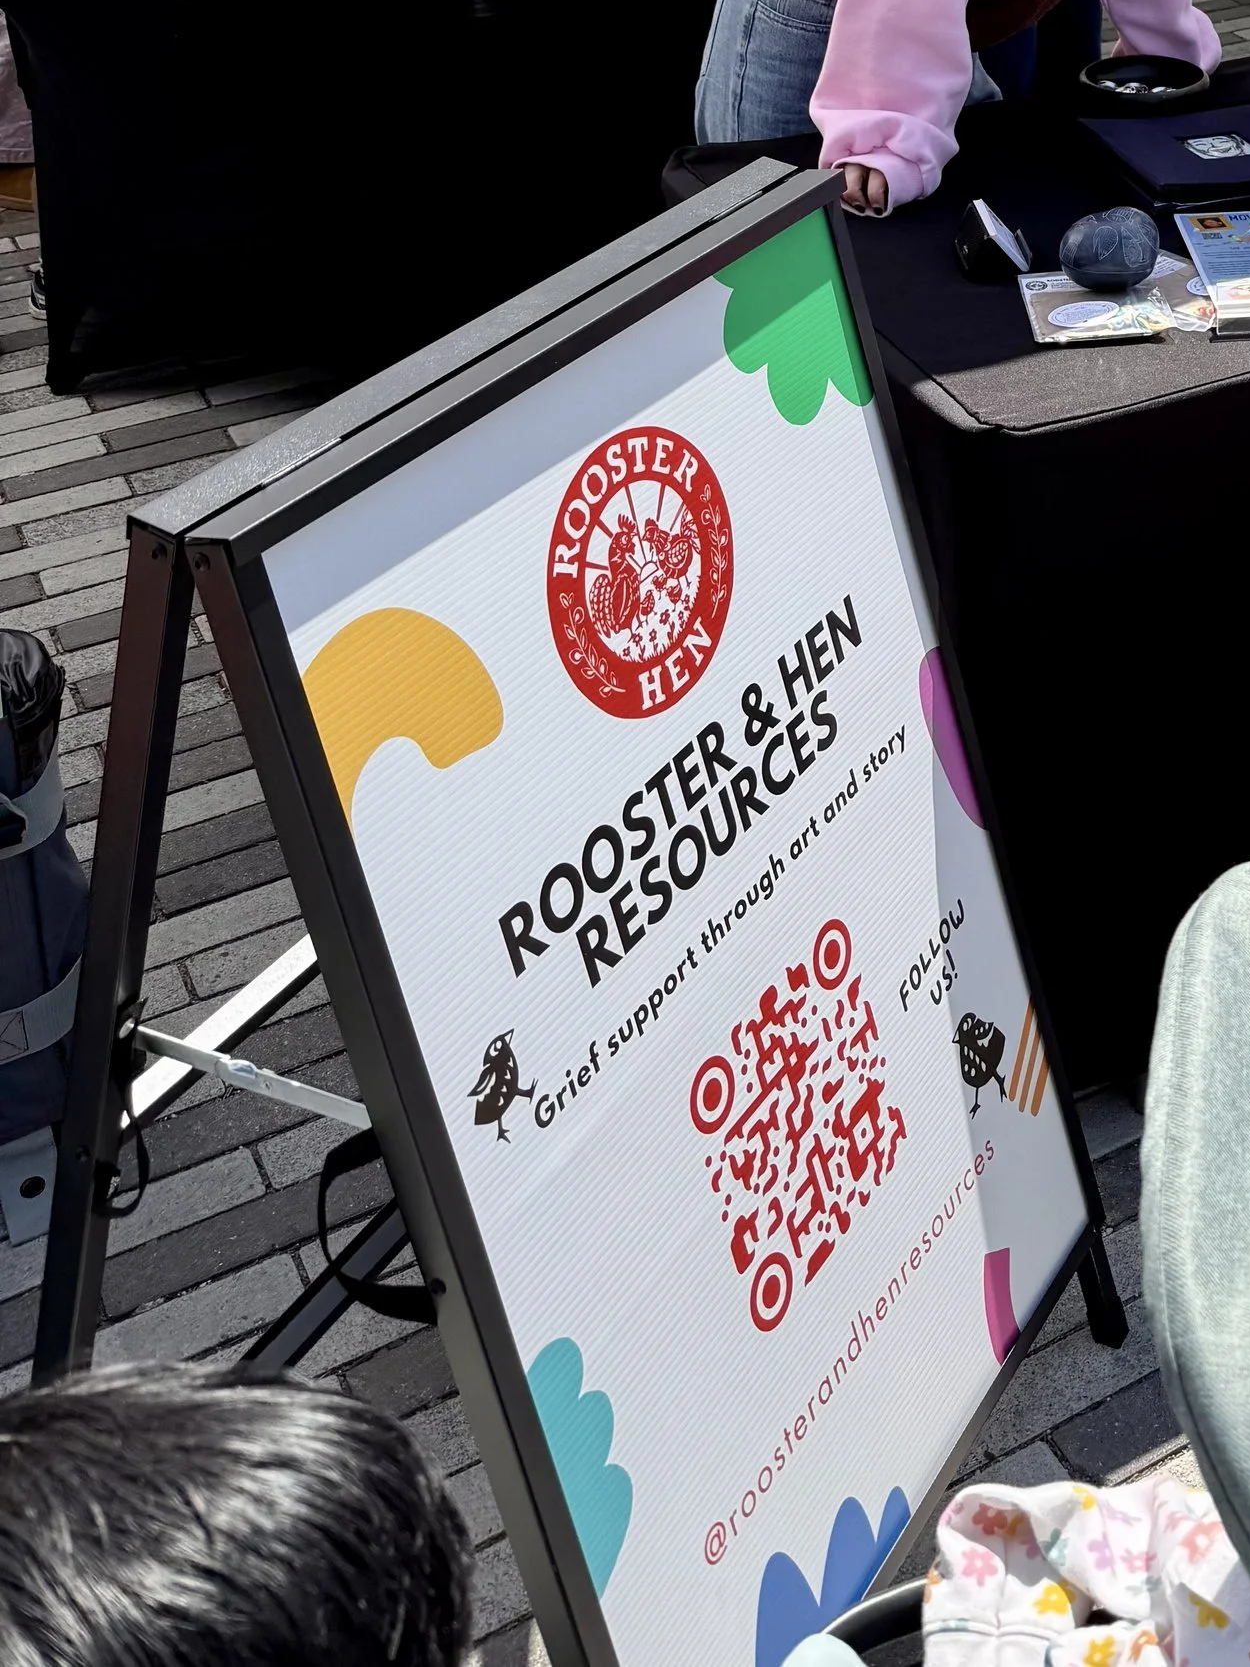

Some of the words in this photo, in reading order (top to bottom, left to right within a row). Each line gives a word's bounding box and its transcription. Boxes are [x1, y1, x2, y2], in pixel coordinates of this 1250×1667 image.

[552, 436, 699, 579] ROOSTER
[638, 616, 712, 711] HEN
[498, 721, 738, 978] ROOSTER
[741, 682, 781, 747] &
[777, 594, 864, 711] HEN
[575, 689, 838, 989] RESOURCES
[534, 1040, 602, 1129] Grief
[607, 946, 699, 1058] support
[701, 853, 786, 954] through
[789, 815, 820, 860] art
[823, 768, 859, 824] and
[862, 724, 907, 783] story
[899, 898, 965, 1013] FOLLOW
[929, 948, 958, 1006] US!
[703, 1138, 995, 1567] @roosterandhenresources
